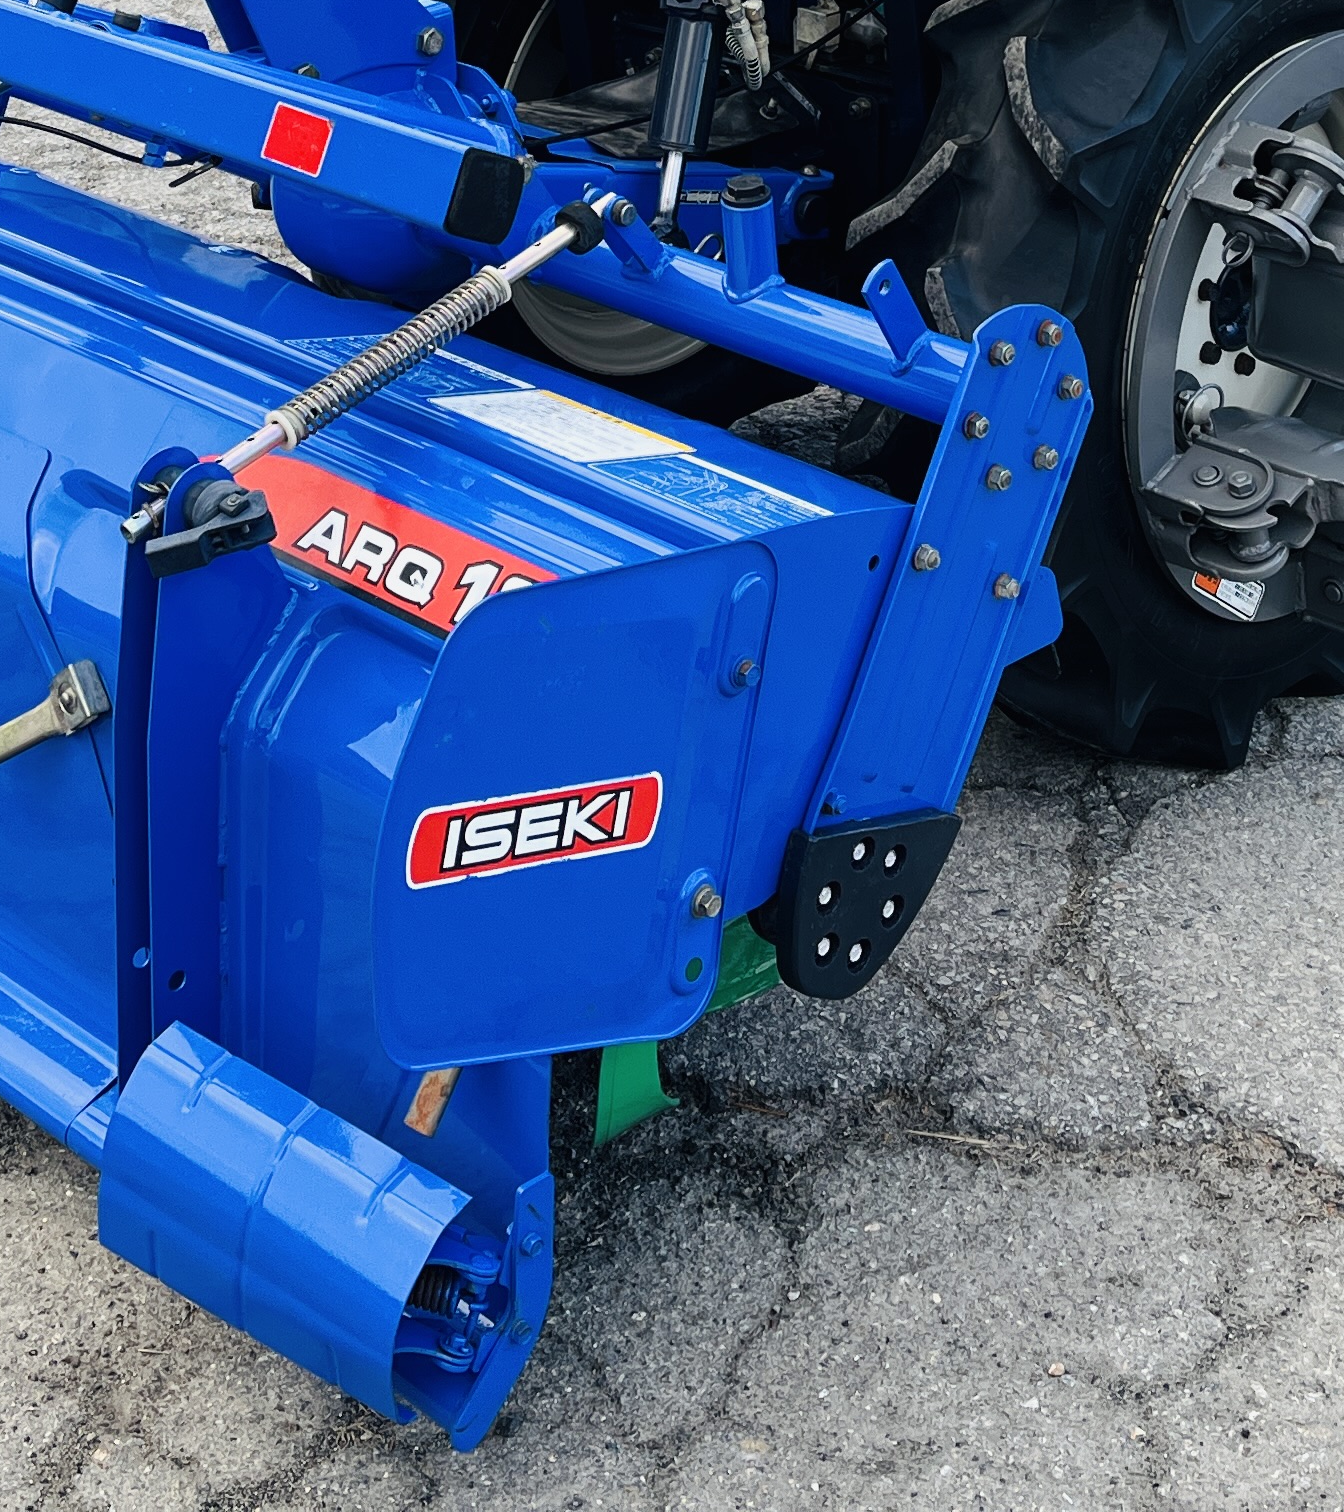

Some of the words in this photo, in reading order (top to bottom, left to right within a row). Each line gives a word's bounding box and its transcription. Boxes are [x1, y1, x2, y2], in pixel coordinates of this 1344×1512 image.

[292, 507, 444, 610] ARQ
[449, 560, 541, 626] 1
[440, 787, 633, 873] ISEKI
